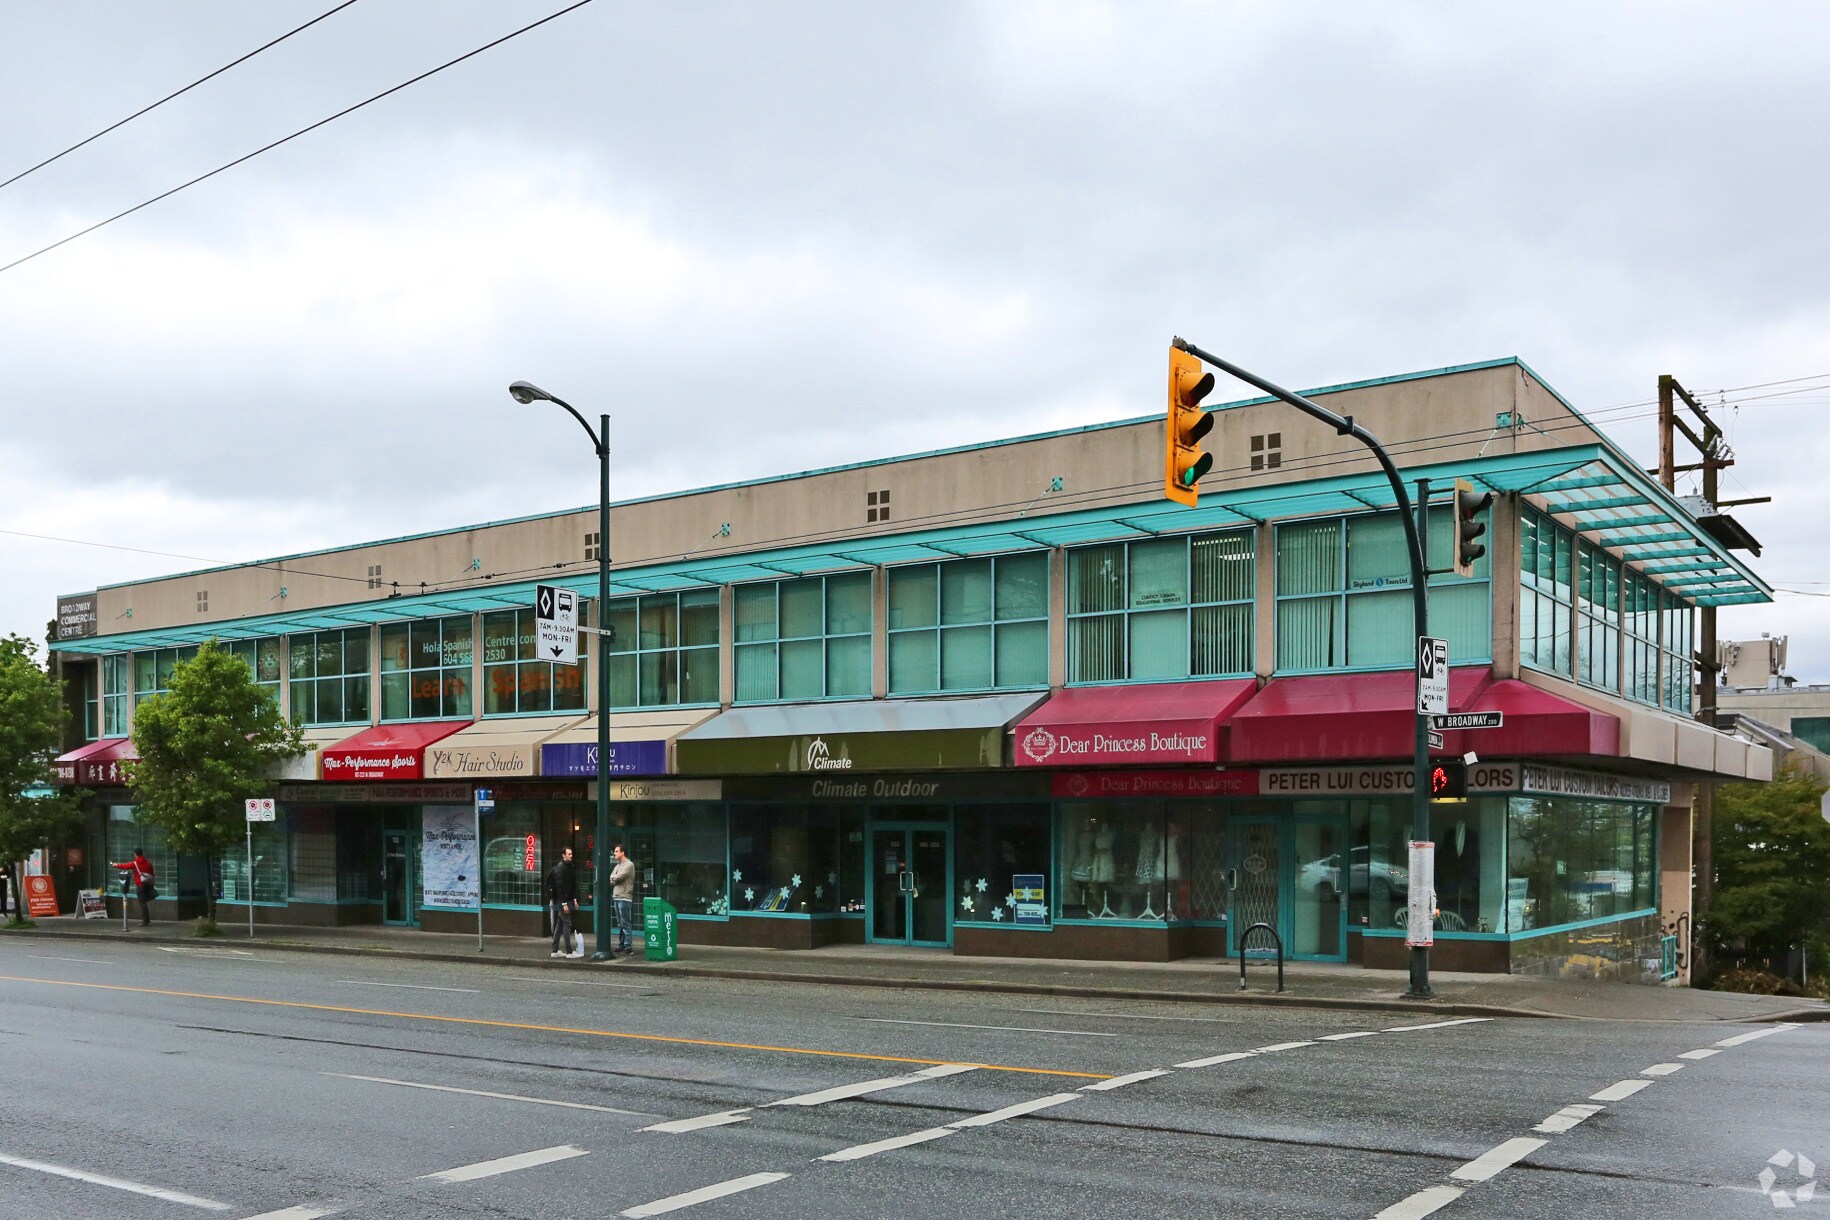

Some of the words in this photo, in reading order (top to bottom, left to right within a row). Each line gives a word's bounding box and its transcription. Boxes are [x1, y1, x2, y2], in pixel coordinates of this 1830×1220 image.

[60, 601, 91, 614] BROADWAY
[60, 612, 97, 625] COMMERCIAL
[60, 625, 83, 637] CENTRE
[423, 642, 442, 654] Hola
[443, 640, 473, 652] Spanish
[485, 648, 506, 661] 2530
[412, 676, 465, 698] Learn
[492, 666, 580, 700] Spanish
[1437, 717, 1444, 727] W
[1447, 714, 1488, 727] BROADWAY
[1060, 735, 1089, 754] Dear
[1094, 734, 1146, 753] Princess
[1150, 732, 1207, 756] Boutique
[391, 754, 416, 770] Sports
[453, 752, 485, 773] Hair
[485, 750, 523, 772] Studio
[814, 756, 852, 770] Climate
[812, 780, 867, 797] Climate
[873, 779, 940, 797] Outdoor
[1101, 777, 1129, 790] Dear
[1133, 776, 1184, 790] Princess
[1188, 776, 1242, 794] Boutique
[1269, 772, 1321, 790] PETER
[1327, 771, 1353, 789] LUI
[1359, 770, 1415, 788] CUSTO
[1523, 765, 1548, 790] PETER
[1550, 768, 1562, 792] LUI
[1564, 769, 1592, 794] CUSTOM
[1593, 772, 1619, 796] TAILORS
[620, 783, 650, 798] Kinjou
[526, 835, 535, 871] OPEN
